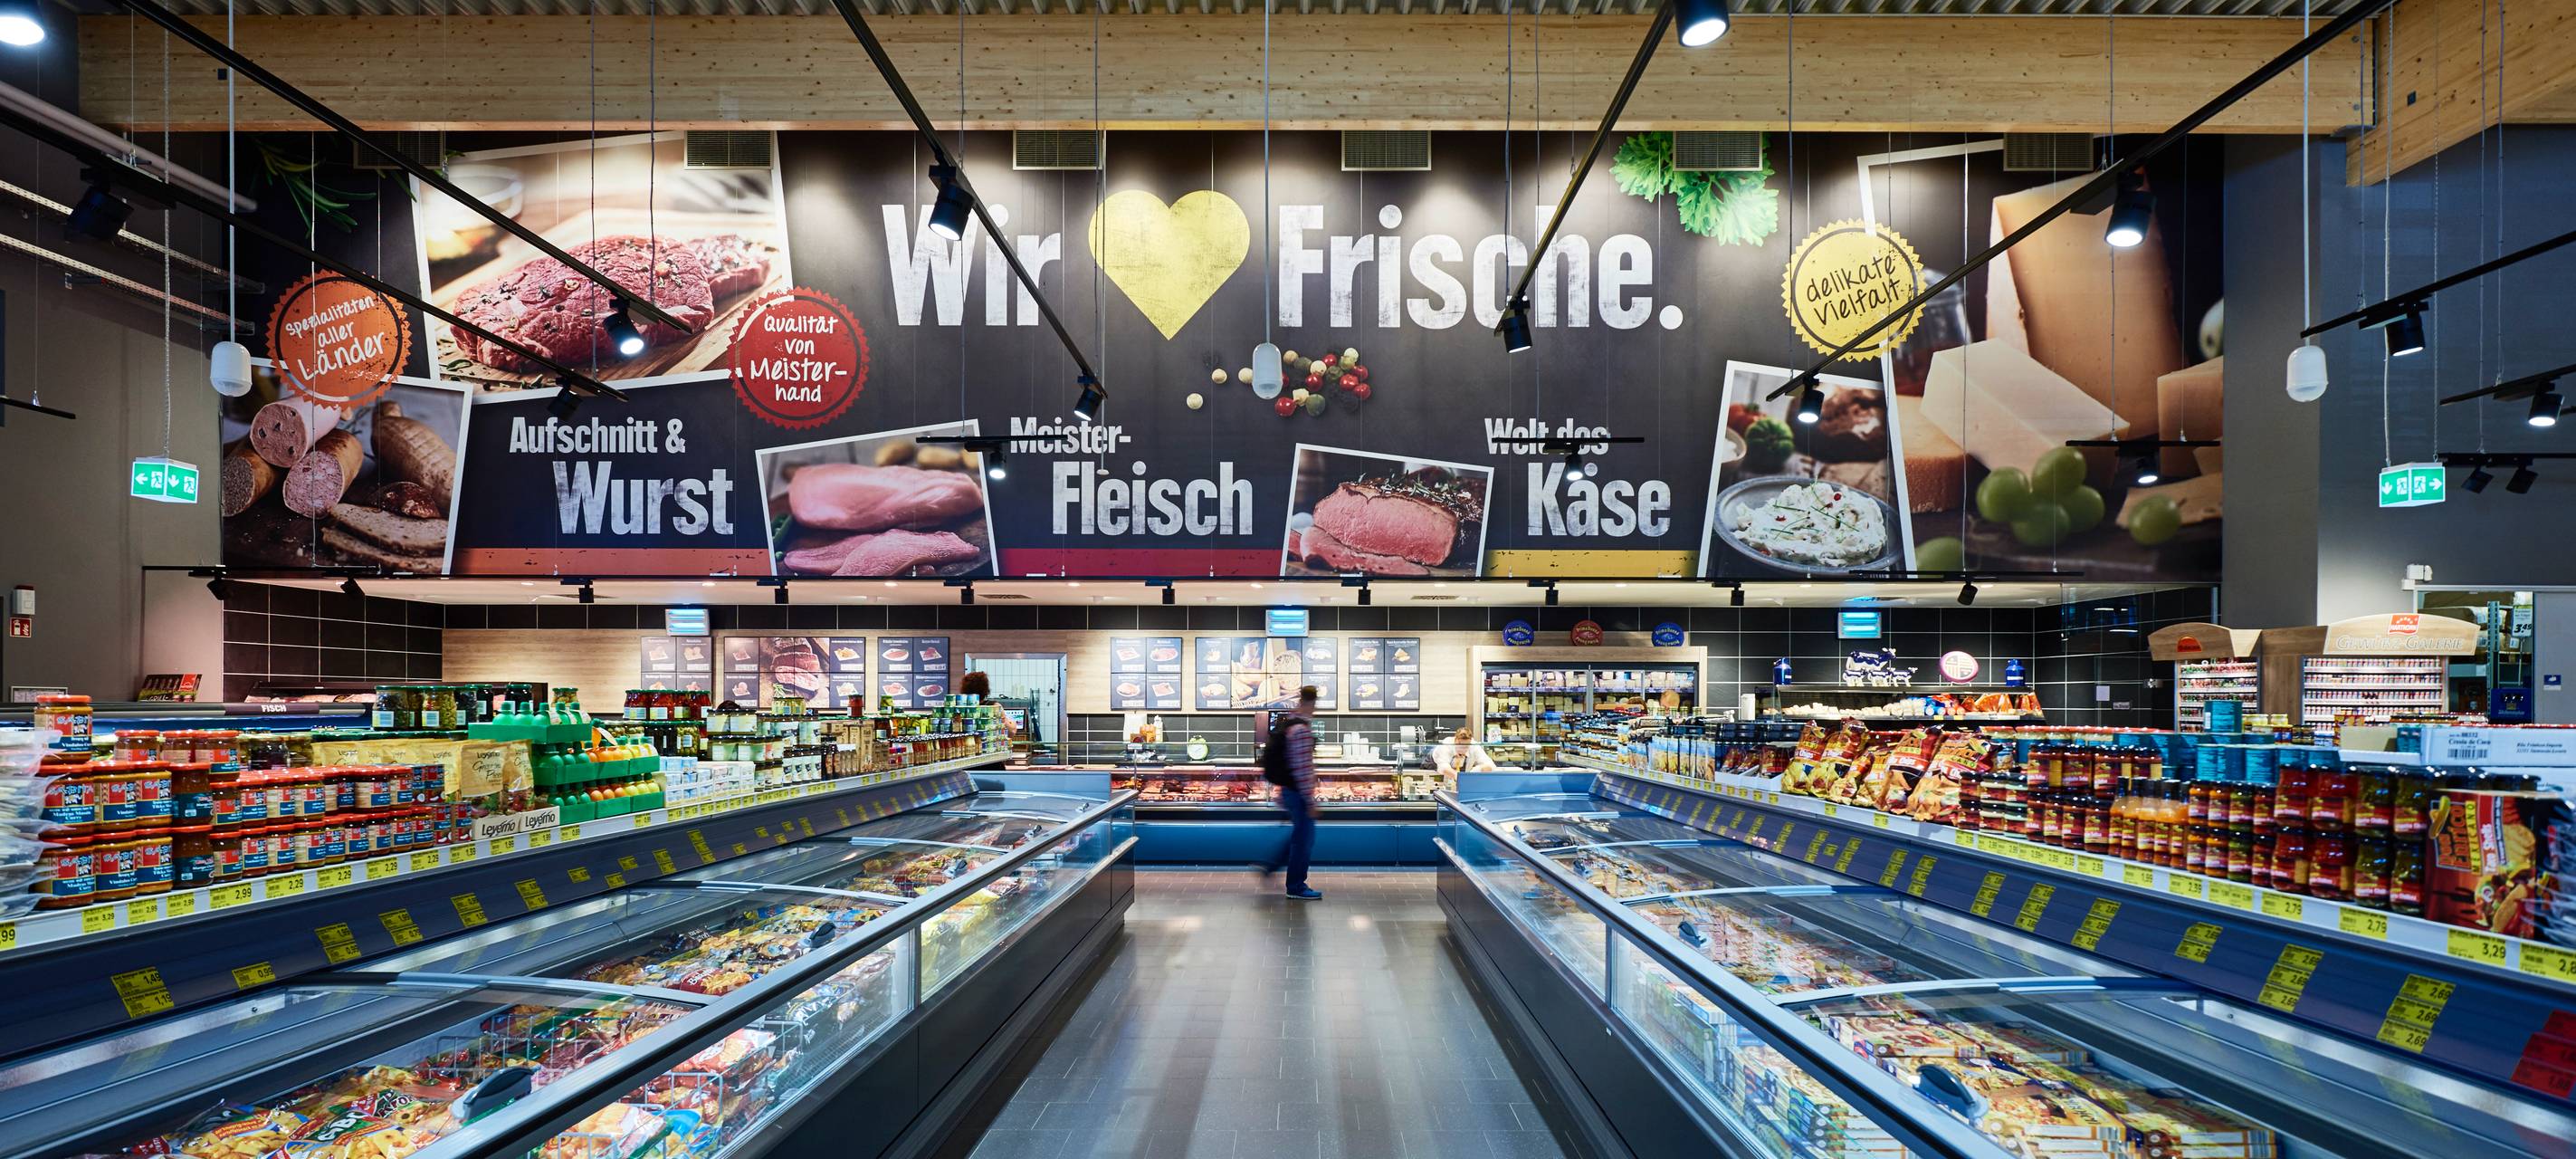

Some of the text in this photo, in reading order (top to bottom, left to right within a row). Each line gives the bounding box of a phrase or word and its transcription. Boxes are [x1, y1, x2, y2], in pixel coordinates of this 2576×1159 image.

[882, 204, 1061, 327] Wir
[1279, 205, 1684, 330] Frische.
[1807, 253, 1896, 303] delikate
[318, 321, 354, 348] aller
[763, 314, 839, 335] Qualität
[297, 331, 385, 381] Länder
[784, 337, 815, 357] von
[749, 358, 848, 382] Meister-
[775, 383, 822, 403] hand
[509, 416, 686, 454] Aufschnitt &
[1009, 417, 1131, 455] Meister-
[1484, 417, 1609, 455] Welt des
[553, 461, 733, 535] Wurst
[1053, 461, 1254, 536] Fleisch
[1528, 463, 1671, 537] Käse
[261, 704, 287, 713] FISCH
[338, 870, 352, 882] 2,29
[385, 861, 398, 873] 2,29
[234, 887, 253, 900] 2,99
[289, 878, 304, 890] 2,29
[2285, 901, 2303, 915] 2,79
[2367, 919, 2388, 934] 2,79
[2482, 942, 2507, 959] 3,29
[155, 993, 172, 1007] 1,19
[2429, 986, 2451, 1001] 2,69
[2416, 1009, 2438, 1023] 2,69
[2405, 1033, 2428, 1048] 2,69
